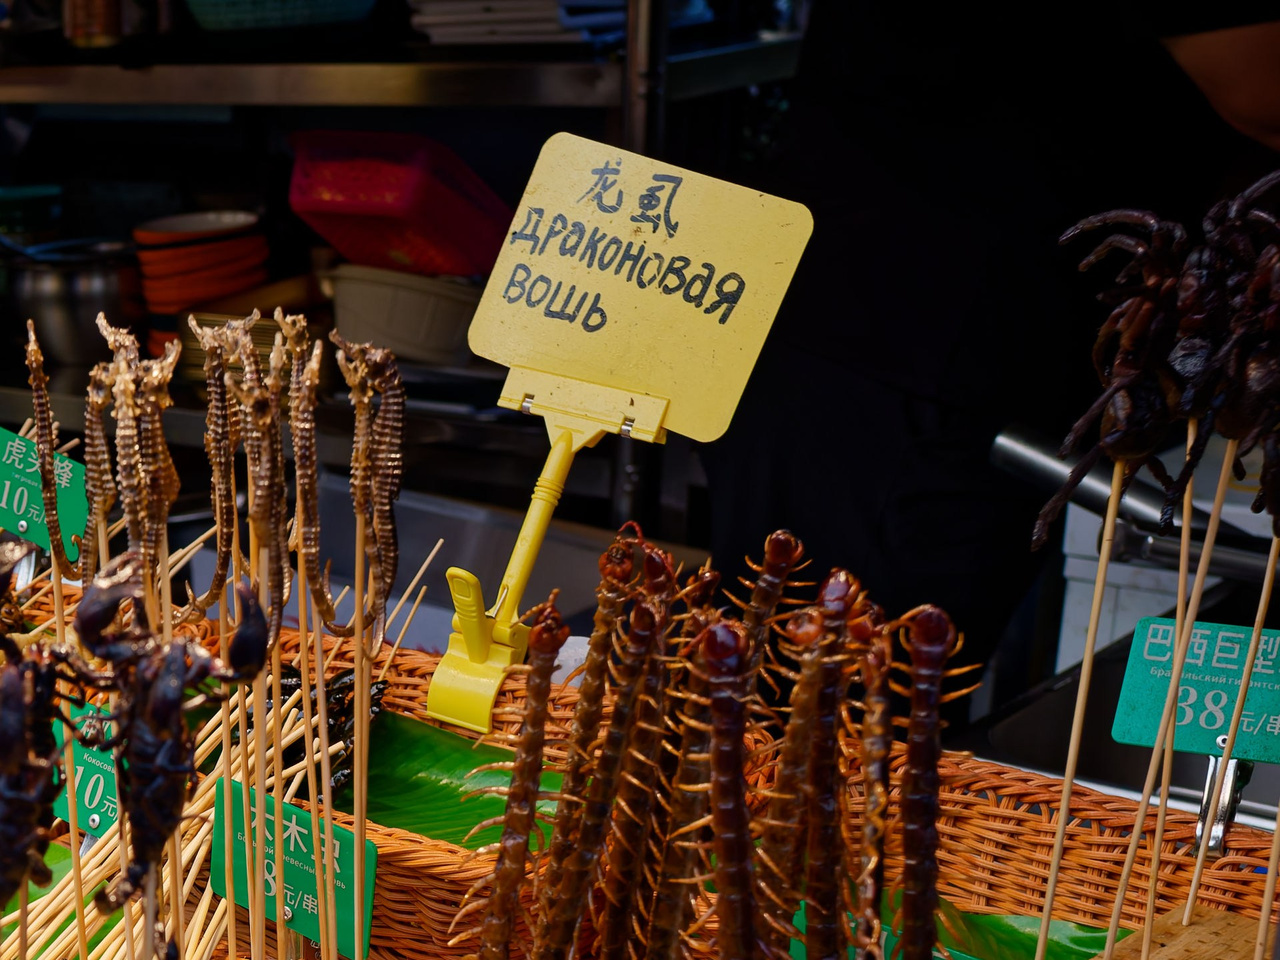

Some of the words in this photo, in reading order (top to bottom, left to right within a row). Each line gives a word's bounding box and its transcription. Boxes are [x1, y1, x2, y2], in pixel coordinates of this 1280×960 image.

[576, 157, 683, 239] 龙虱
[0, 480, 47, 524] 10元/
[1149, 666, 1227, 685] Бральский
